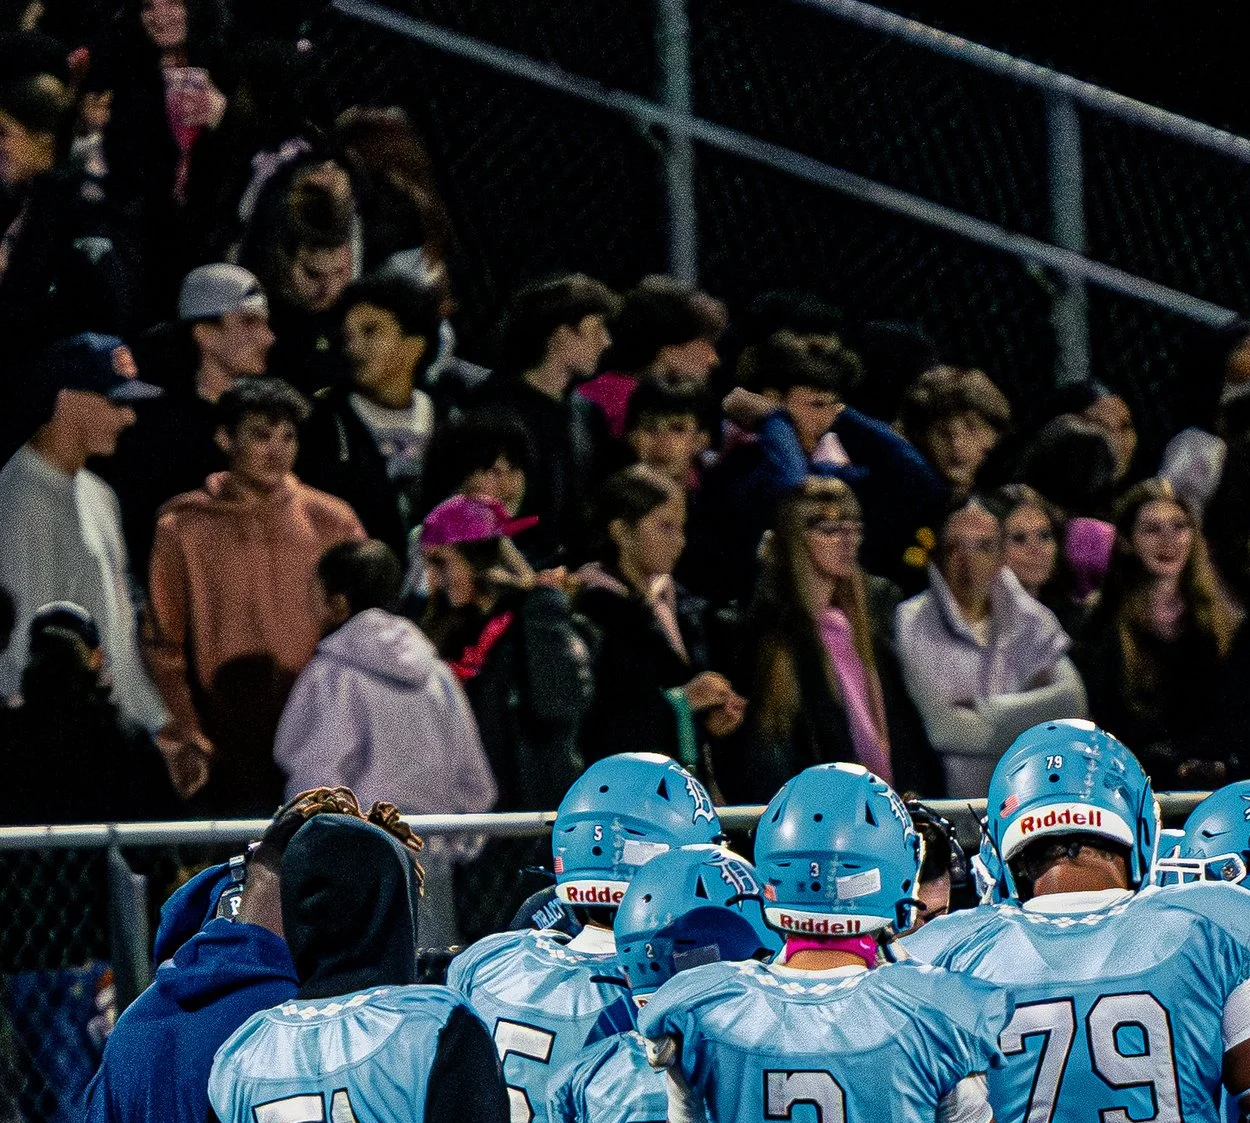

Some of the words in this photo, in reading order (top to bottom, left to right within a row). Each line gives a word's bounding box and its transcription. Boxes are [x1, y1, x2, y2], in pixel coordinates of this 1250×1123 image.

[1046, 755, 1063, 770] 79
[1020, 808, 1102, 835] Riddell
[593, 825, 603, 841] 5
[810, 861, 820, 877] 3
[566, 886, 625, 905] Ridde
[779, 913, 862, 934] Riddell
[645, 943, 654, 958] 2
